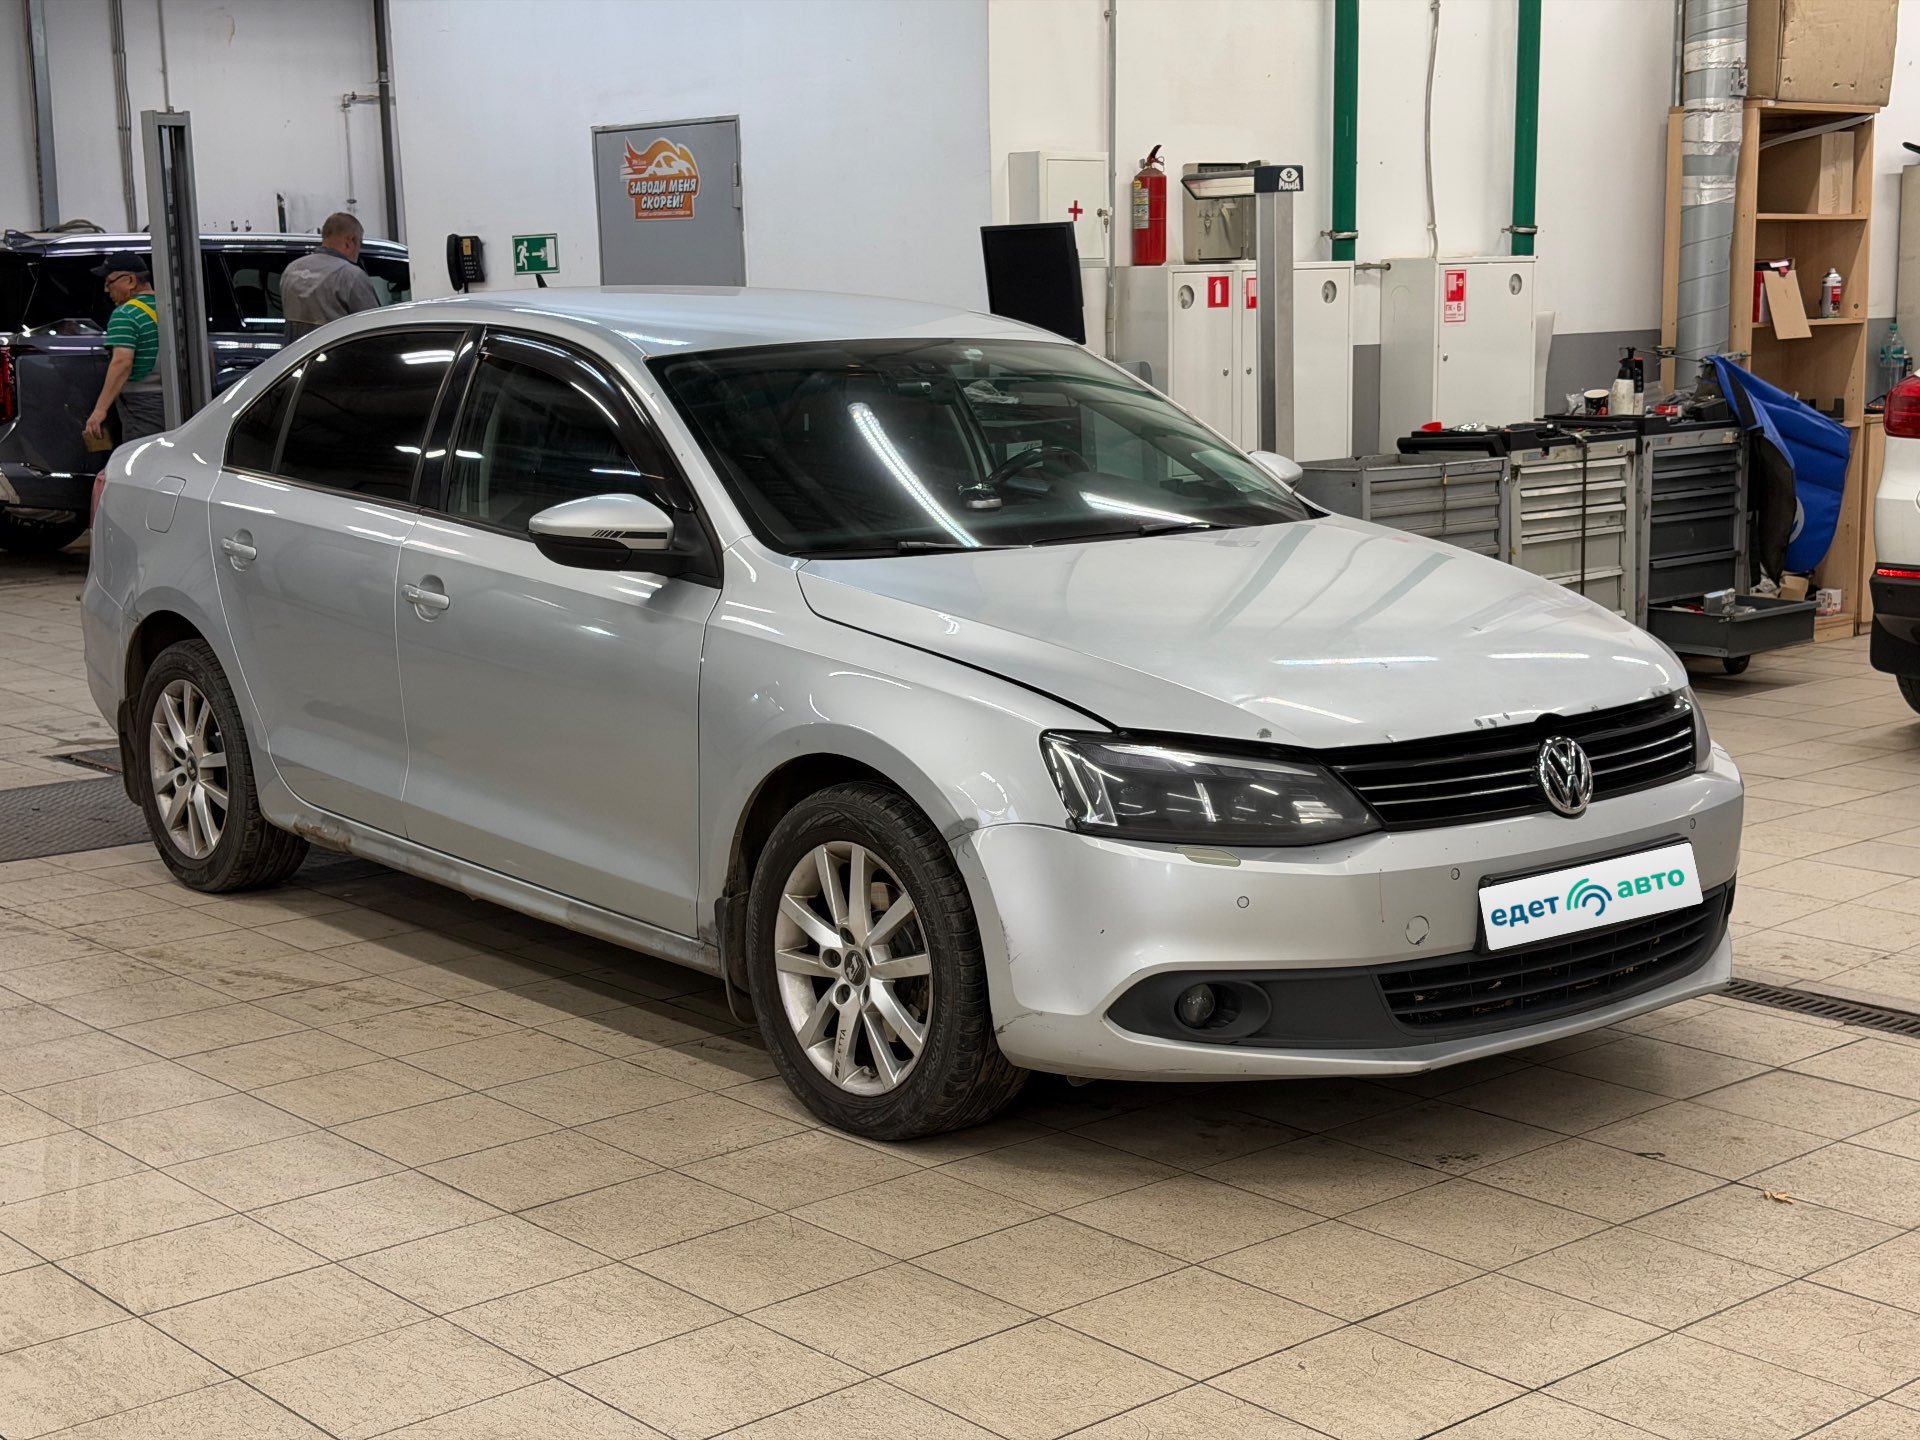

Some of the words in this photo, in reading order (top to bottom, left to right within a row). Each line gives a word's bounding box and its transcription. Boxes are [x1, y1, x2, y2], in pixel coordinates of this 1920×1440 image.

[630, 180, 667, 195] ЗАВОДИ
[669, 178, 697, 193] МЕНЯ
[641, 192, 684, 209] СКОРЕЙ!
